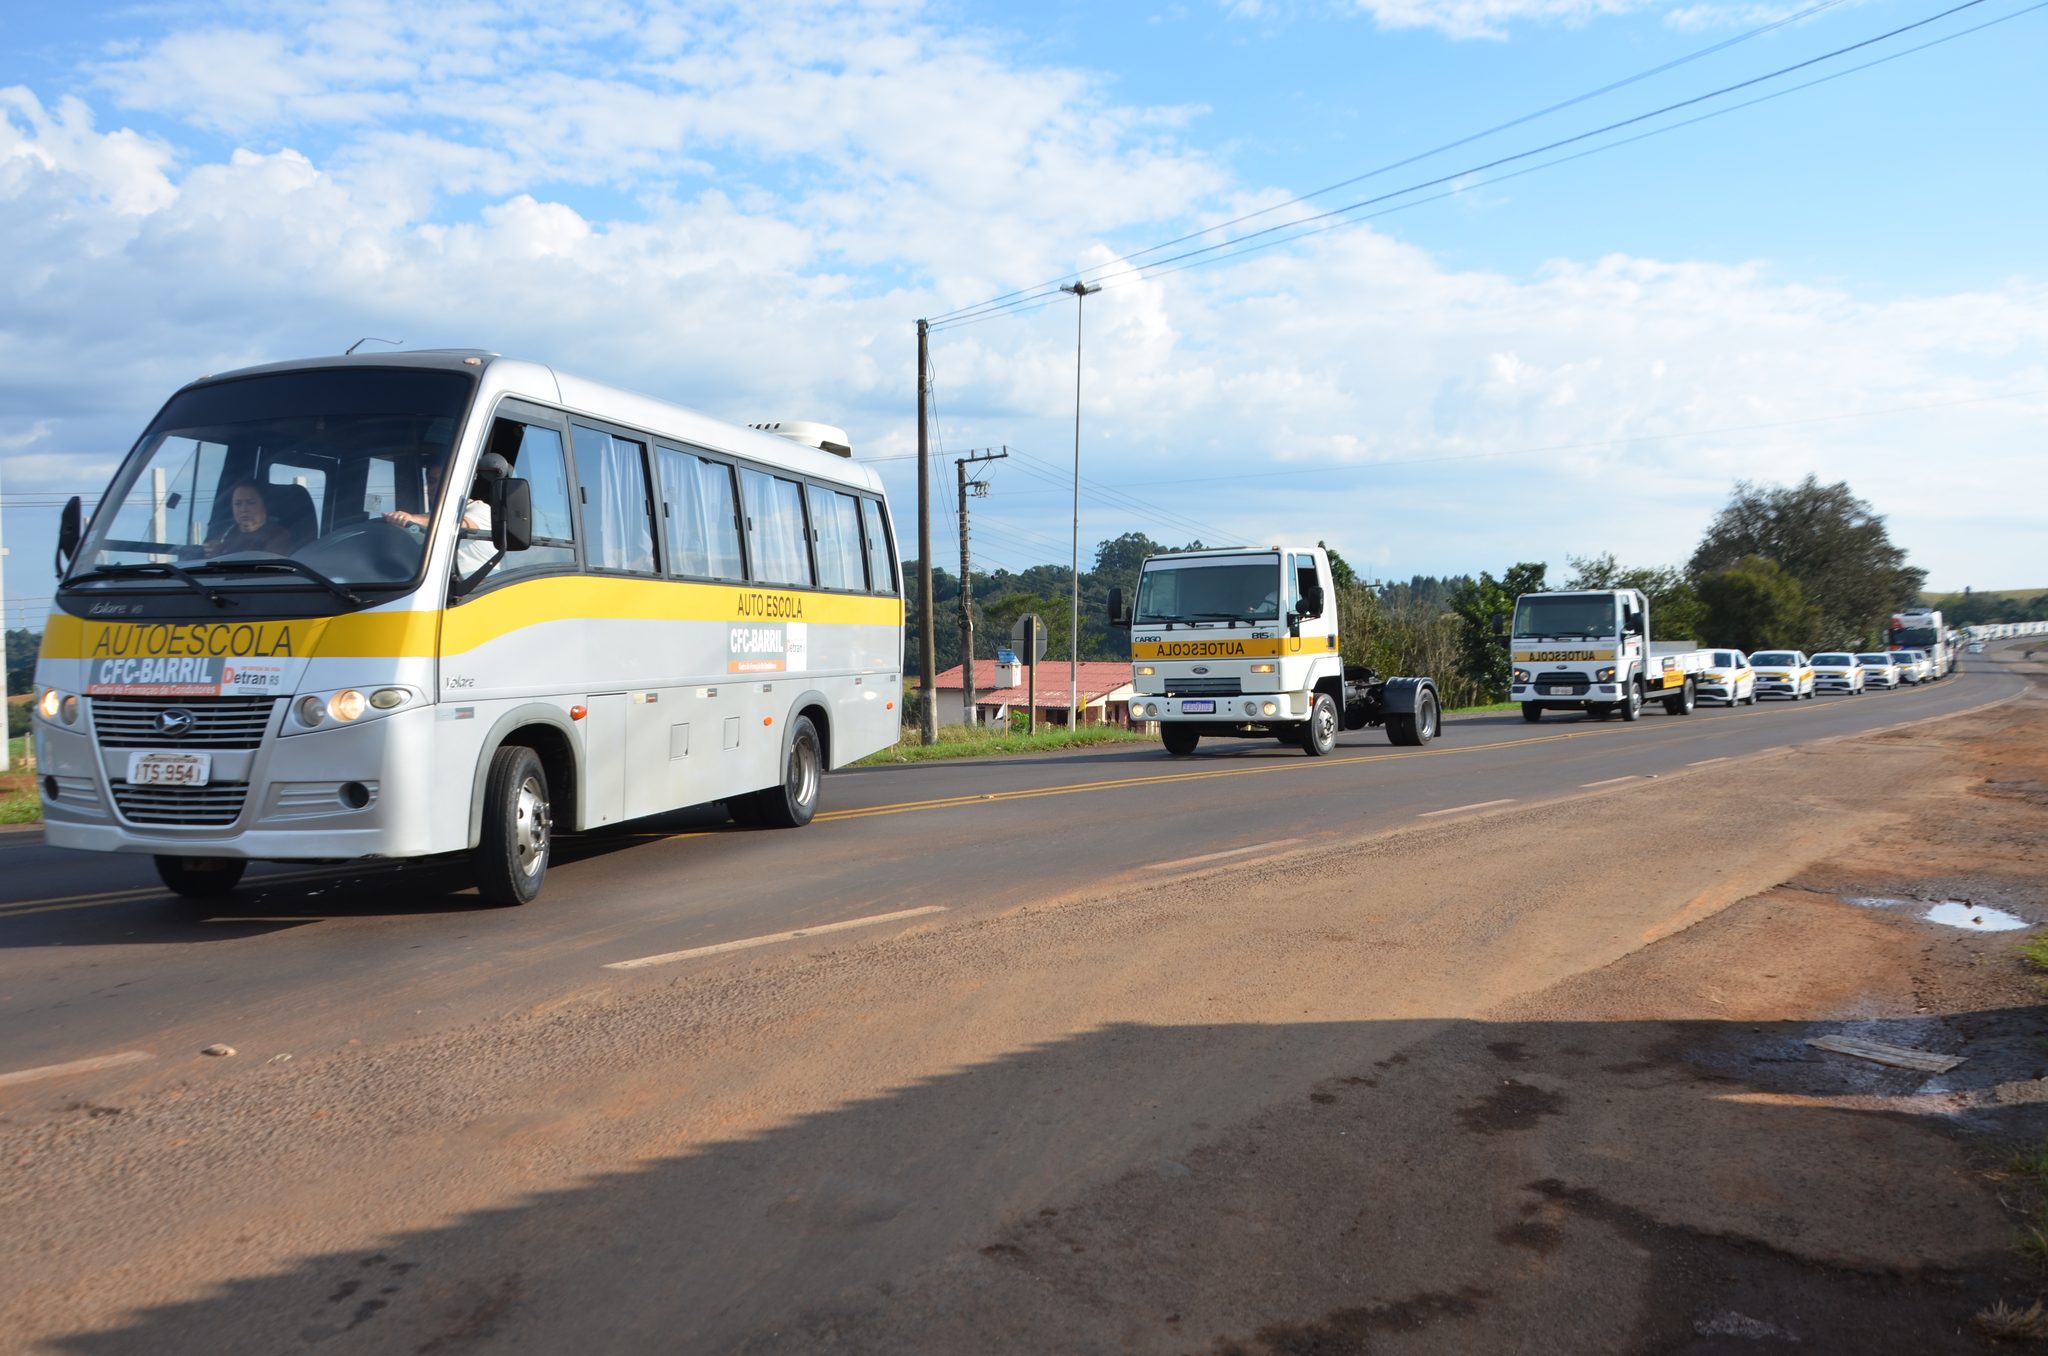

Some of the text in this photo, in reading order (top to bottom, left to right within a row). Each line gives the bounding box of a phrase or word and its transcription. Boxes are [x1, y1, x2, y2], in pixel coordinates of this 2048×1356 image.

[737, 593, 803, 619] AUTO ESCOLA
[92, 622, 292, 658] AUTOESCOLA
[730, 628, 784, 653] CFC-BARRIL
[1134, 635, 1162, 643] CARGO
[100, 657, 212, 684] CFC-BARRIL
[223, 667, 267, 685] Detran
